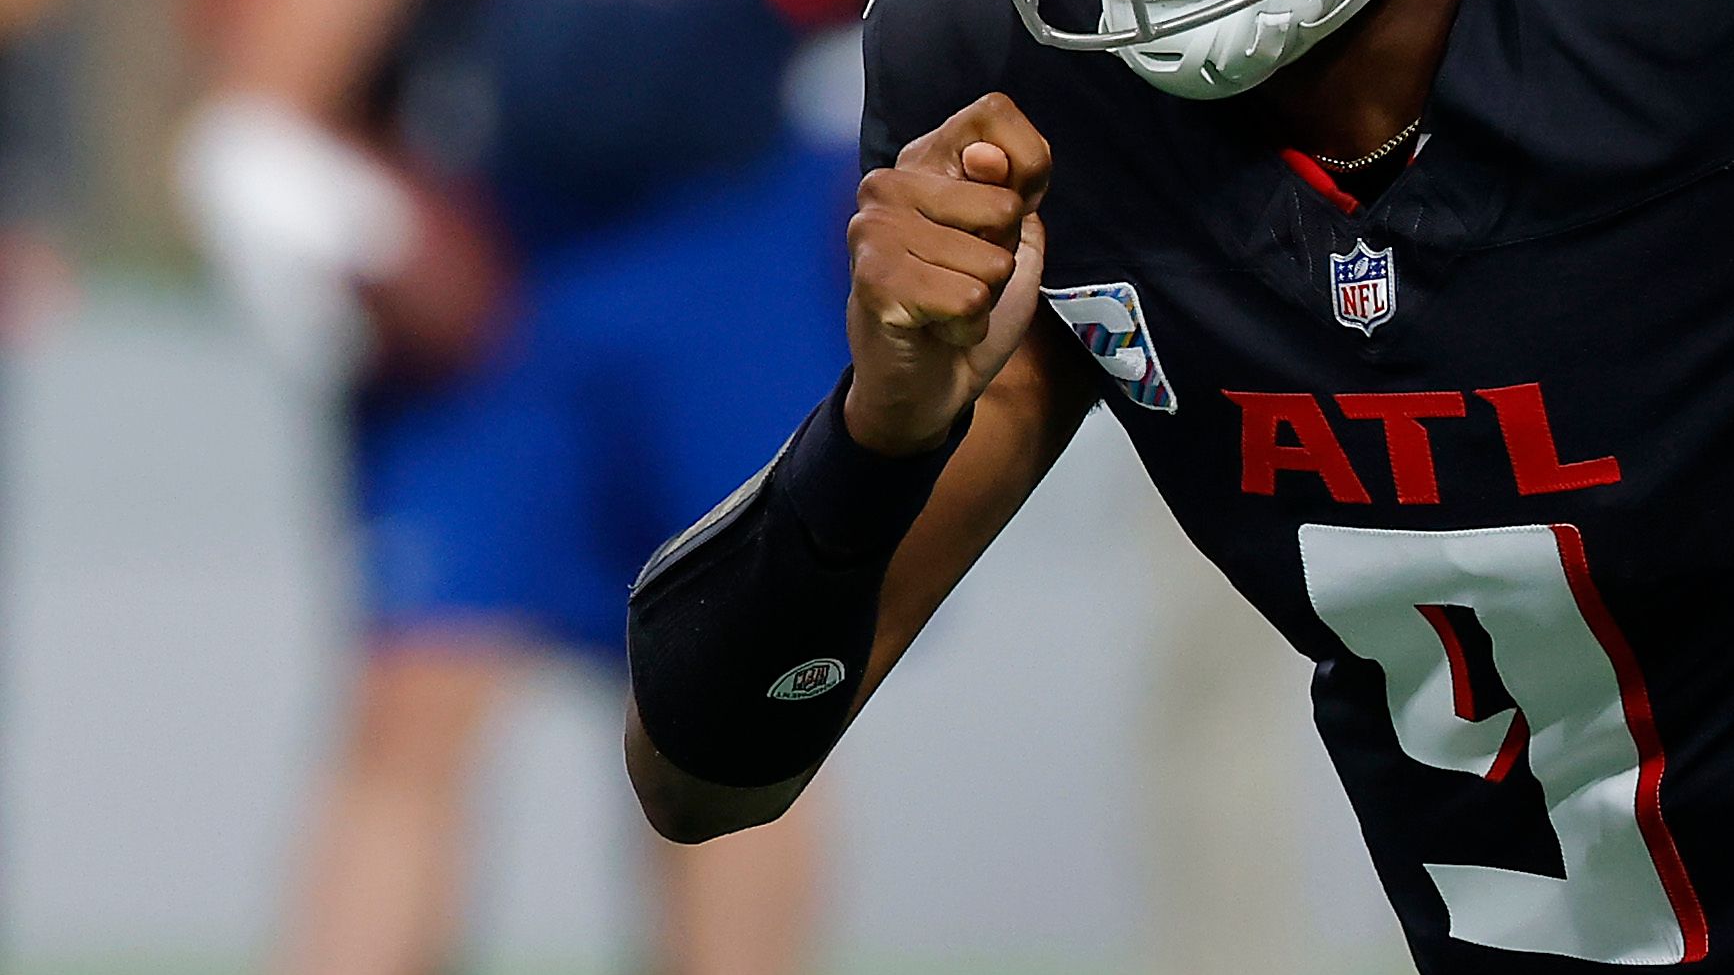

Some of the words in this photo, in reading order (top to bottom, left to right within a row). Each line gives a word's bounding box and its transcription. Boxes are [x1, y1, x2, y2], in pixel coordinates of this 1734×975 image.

[1340, 283, 1386, 320] NFL
[1220, 382, 1623, 505] ATL
[1297, 523, 1709, 967] 9
